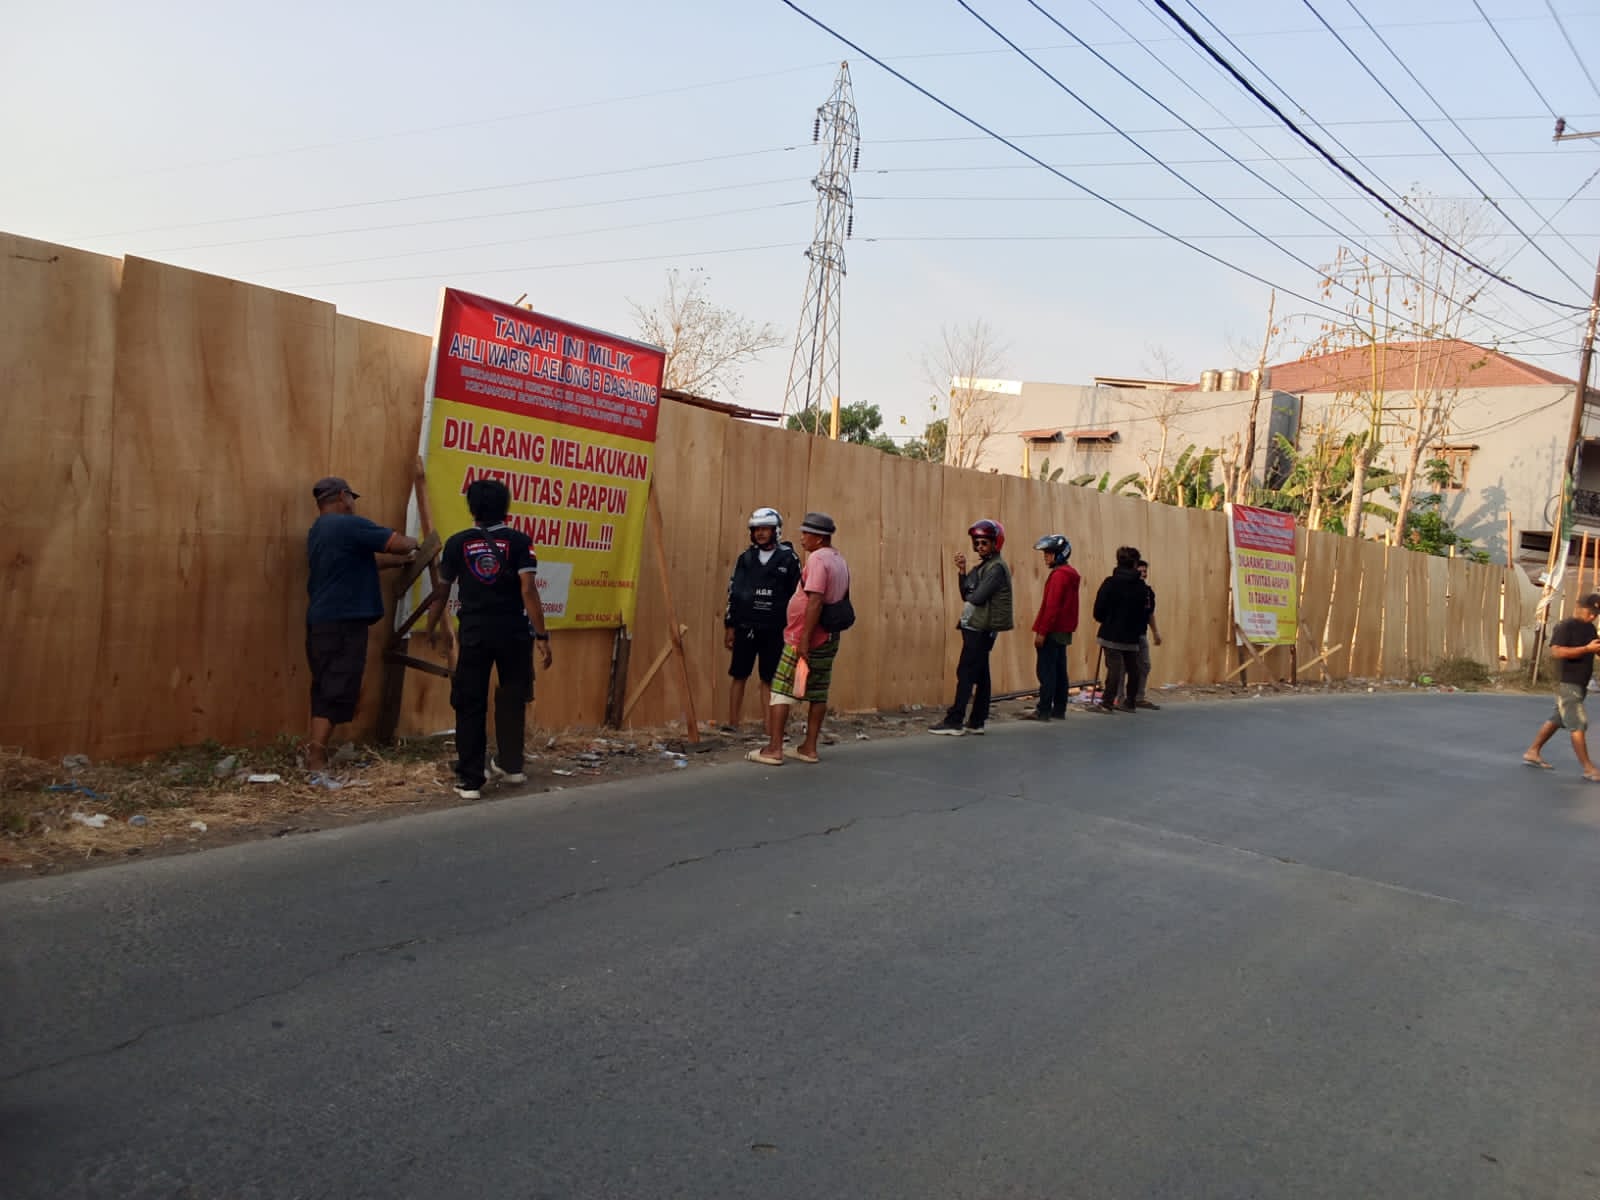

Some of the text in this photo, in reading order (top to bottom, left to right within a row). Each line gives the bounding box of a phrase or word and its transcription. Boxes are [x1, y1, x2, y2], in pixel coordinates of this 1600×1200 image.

[449, 333, 485, 363] AHLI
[487, 341, 530, 373] WARIS
[532, 354, 591, 389] LAELONG
[591, 370, 601, 391] B
[603, 374, 657, 405] BASARING
[493, 315, 633, 376] TANAH INI MILIK
[443, 417, 648, 481] DILARANG MELAKUKAN
[566, 481, 627, 514] APAPUN
